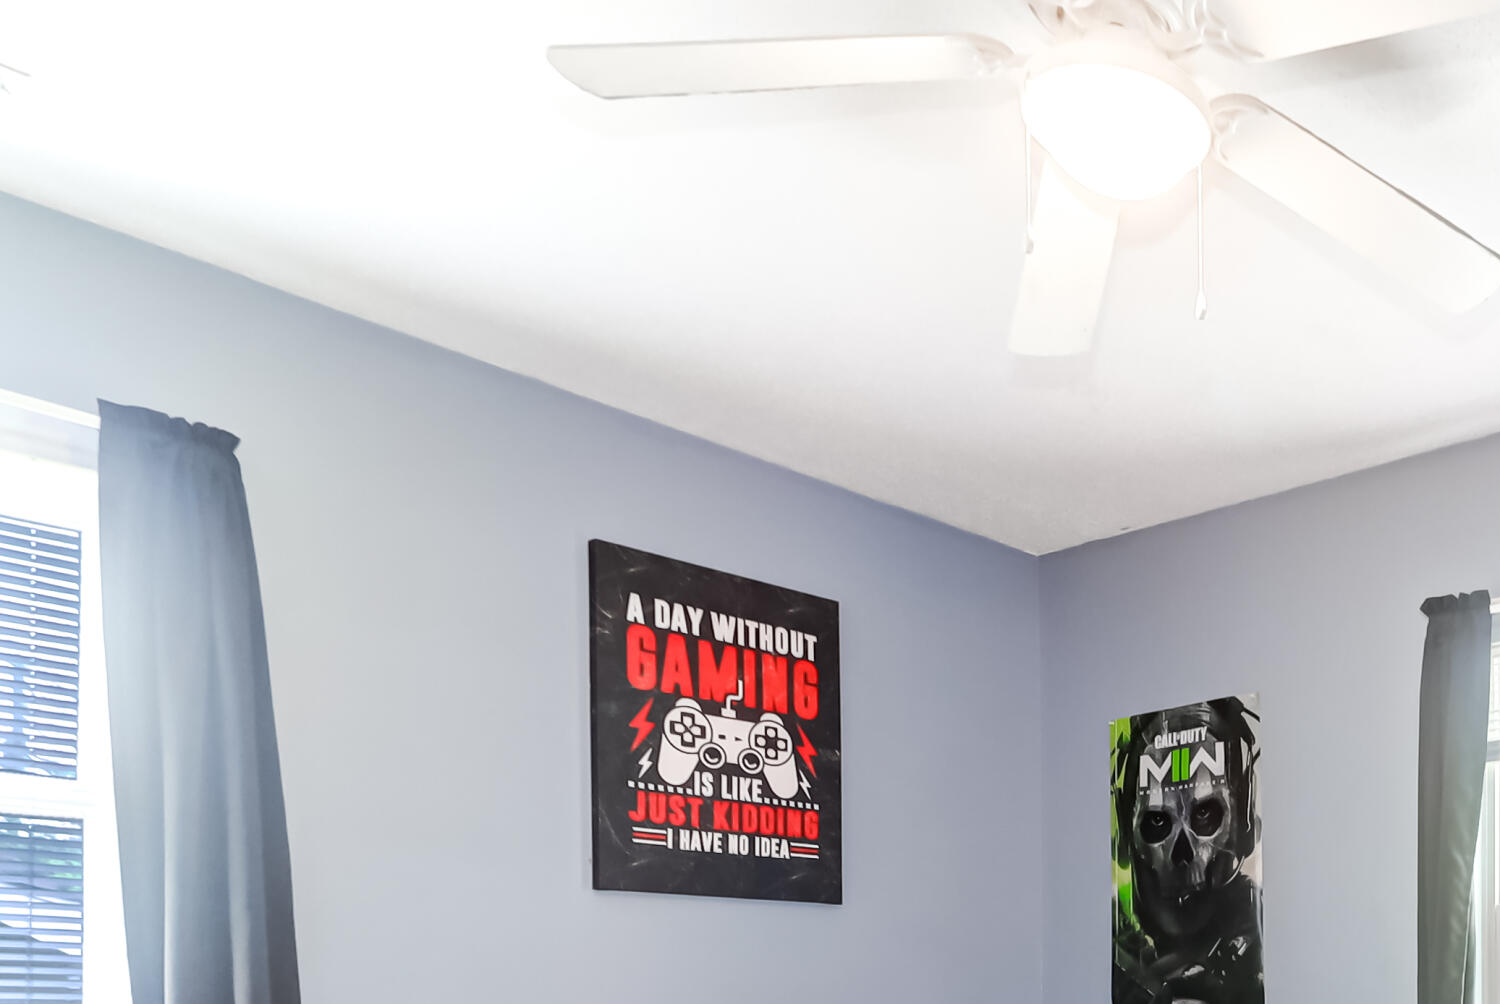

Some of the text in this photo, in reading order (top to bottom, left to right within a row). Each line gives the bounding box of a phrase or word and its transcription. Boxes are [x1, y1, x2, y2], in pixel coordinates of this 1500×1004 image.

[626, 592, 817, 662] A DAY WITHOUT
[626, 623, 819, 720] GAMING
[694, 771, 714, 797] IS
[628, 790, 819, 840] JUST KIDDING
[666, 828, 791, 859] I HAVE NO IDEA
